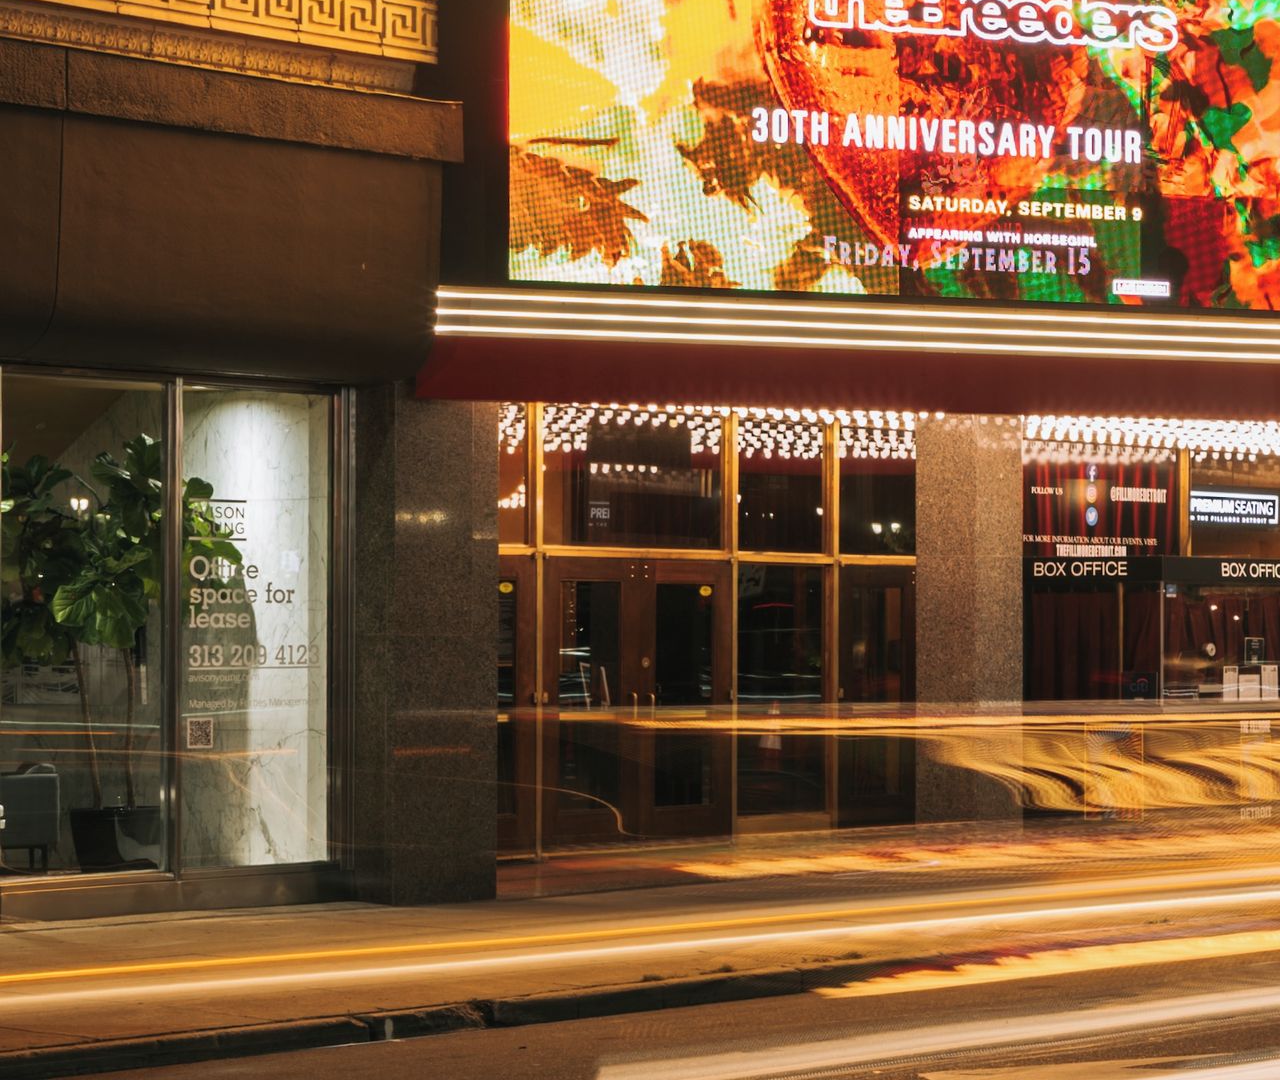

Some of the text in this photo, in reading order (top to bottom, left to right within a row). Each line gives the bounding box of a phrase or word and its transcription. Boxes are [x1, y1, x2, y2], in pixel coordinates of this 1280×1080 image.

[751, 107, 1143, 165] 30TH ANNIVERSARY TOUR
[908, 194, 1143, 222] SATURDAY, SEPTEMBER 9
[908, 227, 984, 244] APPEARING
[986, 230, 1021, 246] WITH
[930, 240, 1057, 276] SEPTEMBER
[1067, 247, 1091, 277] 15
[1031, 486, 1063, 496] FOLLOW US
[1190, 497, 1273, 516] PREMIUM SEATING
[1023, 534, 1034, 543] FOR
[1035, 535, 1051, 543] MORE
[1052, 535, 1090, 544] INFORMATION
[1090, 536, 1109, 545] ABOUT
[1109, 537, 1121, 545] OUR
[189, 555, 259, 580] Office
[1033, 561, 1128, 577] BOX OFFICE
[1221, 562, 1247, 578] BOX
[189, 582, 295, 610] space for
[189, 605, 251, 629] lease
[189, 644, 320, 667] 313 209 4123
[188, 699, 226, 710] Managed
[227, 698, 238, 709] by
[1240, 806, 1272, 820] DETROIT
